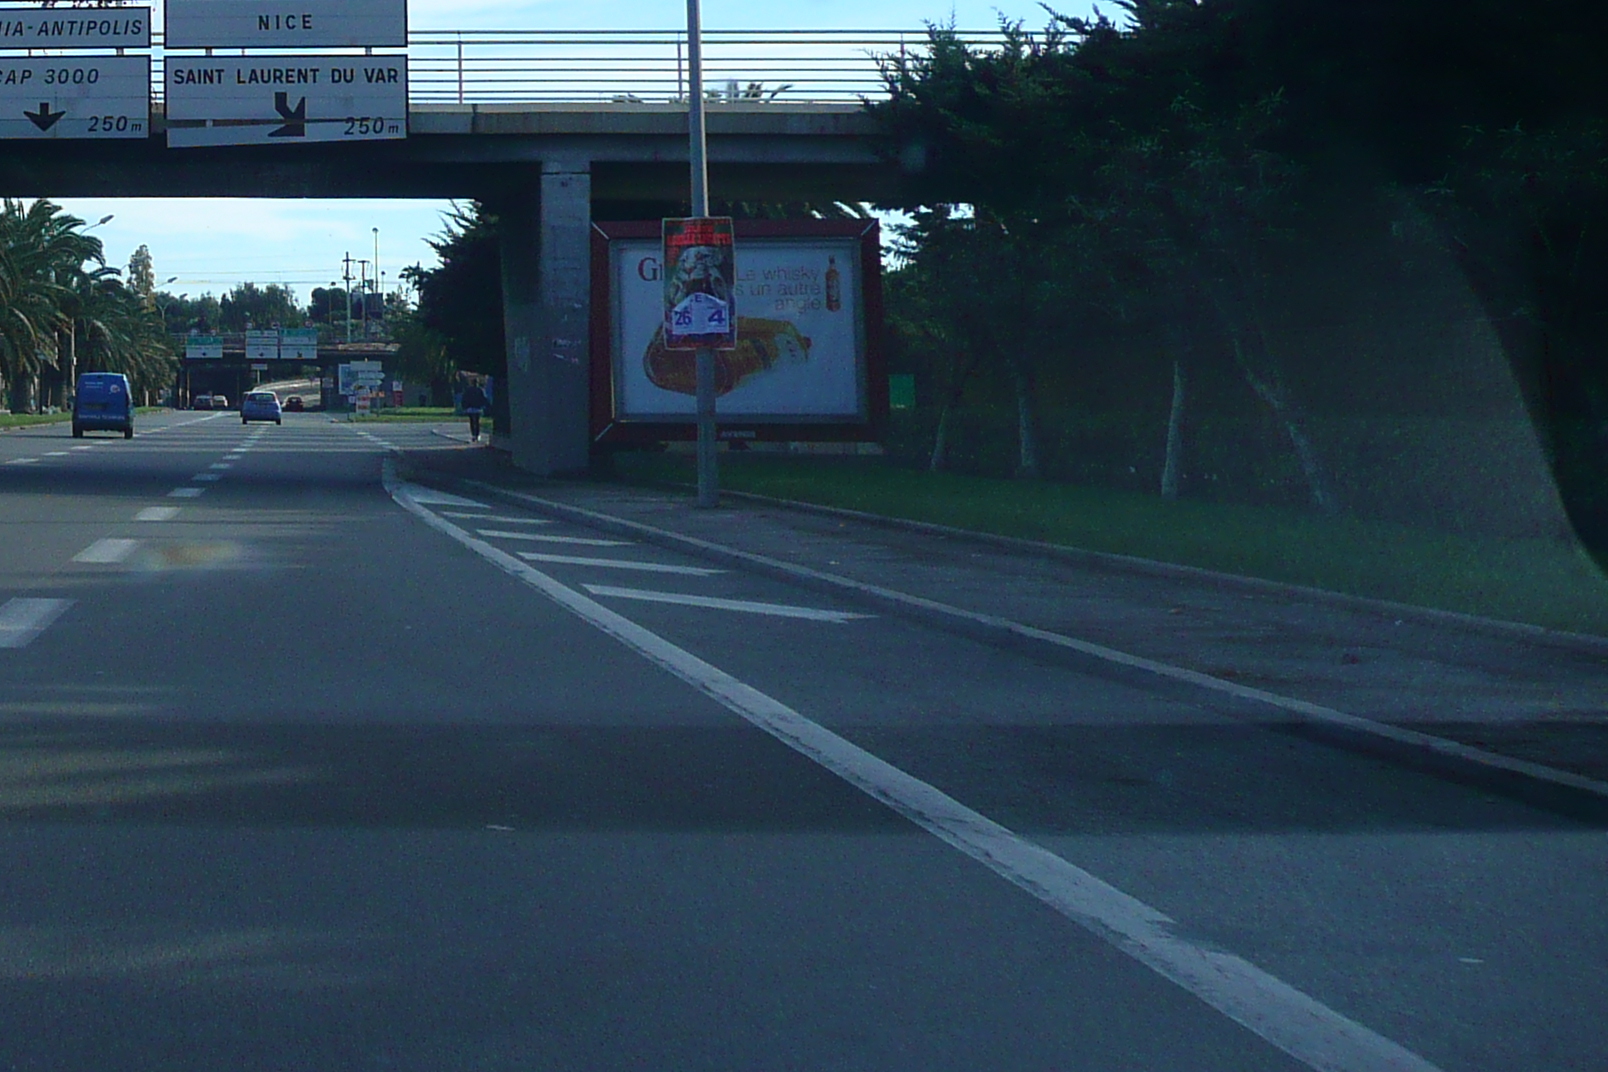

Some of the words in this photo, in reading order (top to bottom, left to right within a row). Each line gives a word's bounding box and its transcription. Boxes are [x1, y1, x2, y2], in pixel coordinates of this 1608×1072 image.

[258, 14, 312, 30] NICE
[44, 68, 99, 84] 3000
[173, 68, 225, 84] SAINT
[237, 68, 320, 84] LAURENT
[331, 68, 354, 84] DU
[364, 68, 398, 84] VAR
[87, 116, 128, 132] 250
[344, 117, 385, 135] 250
[777, 281, 821, 296] autre
